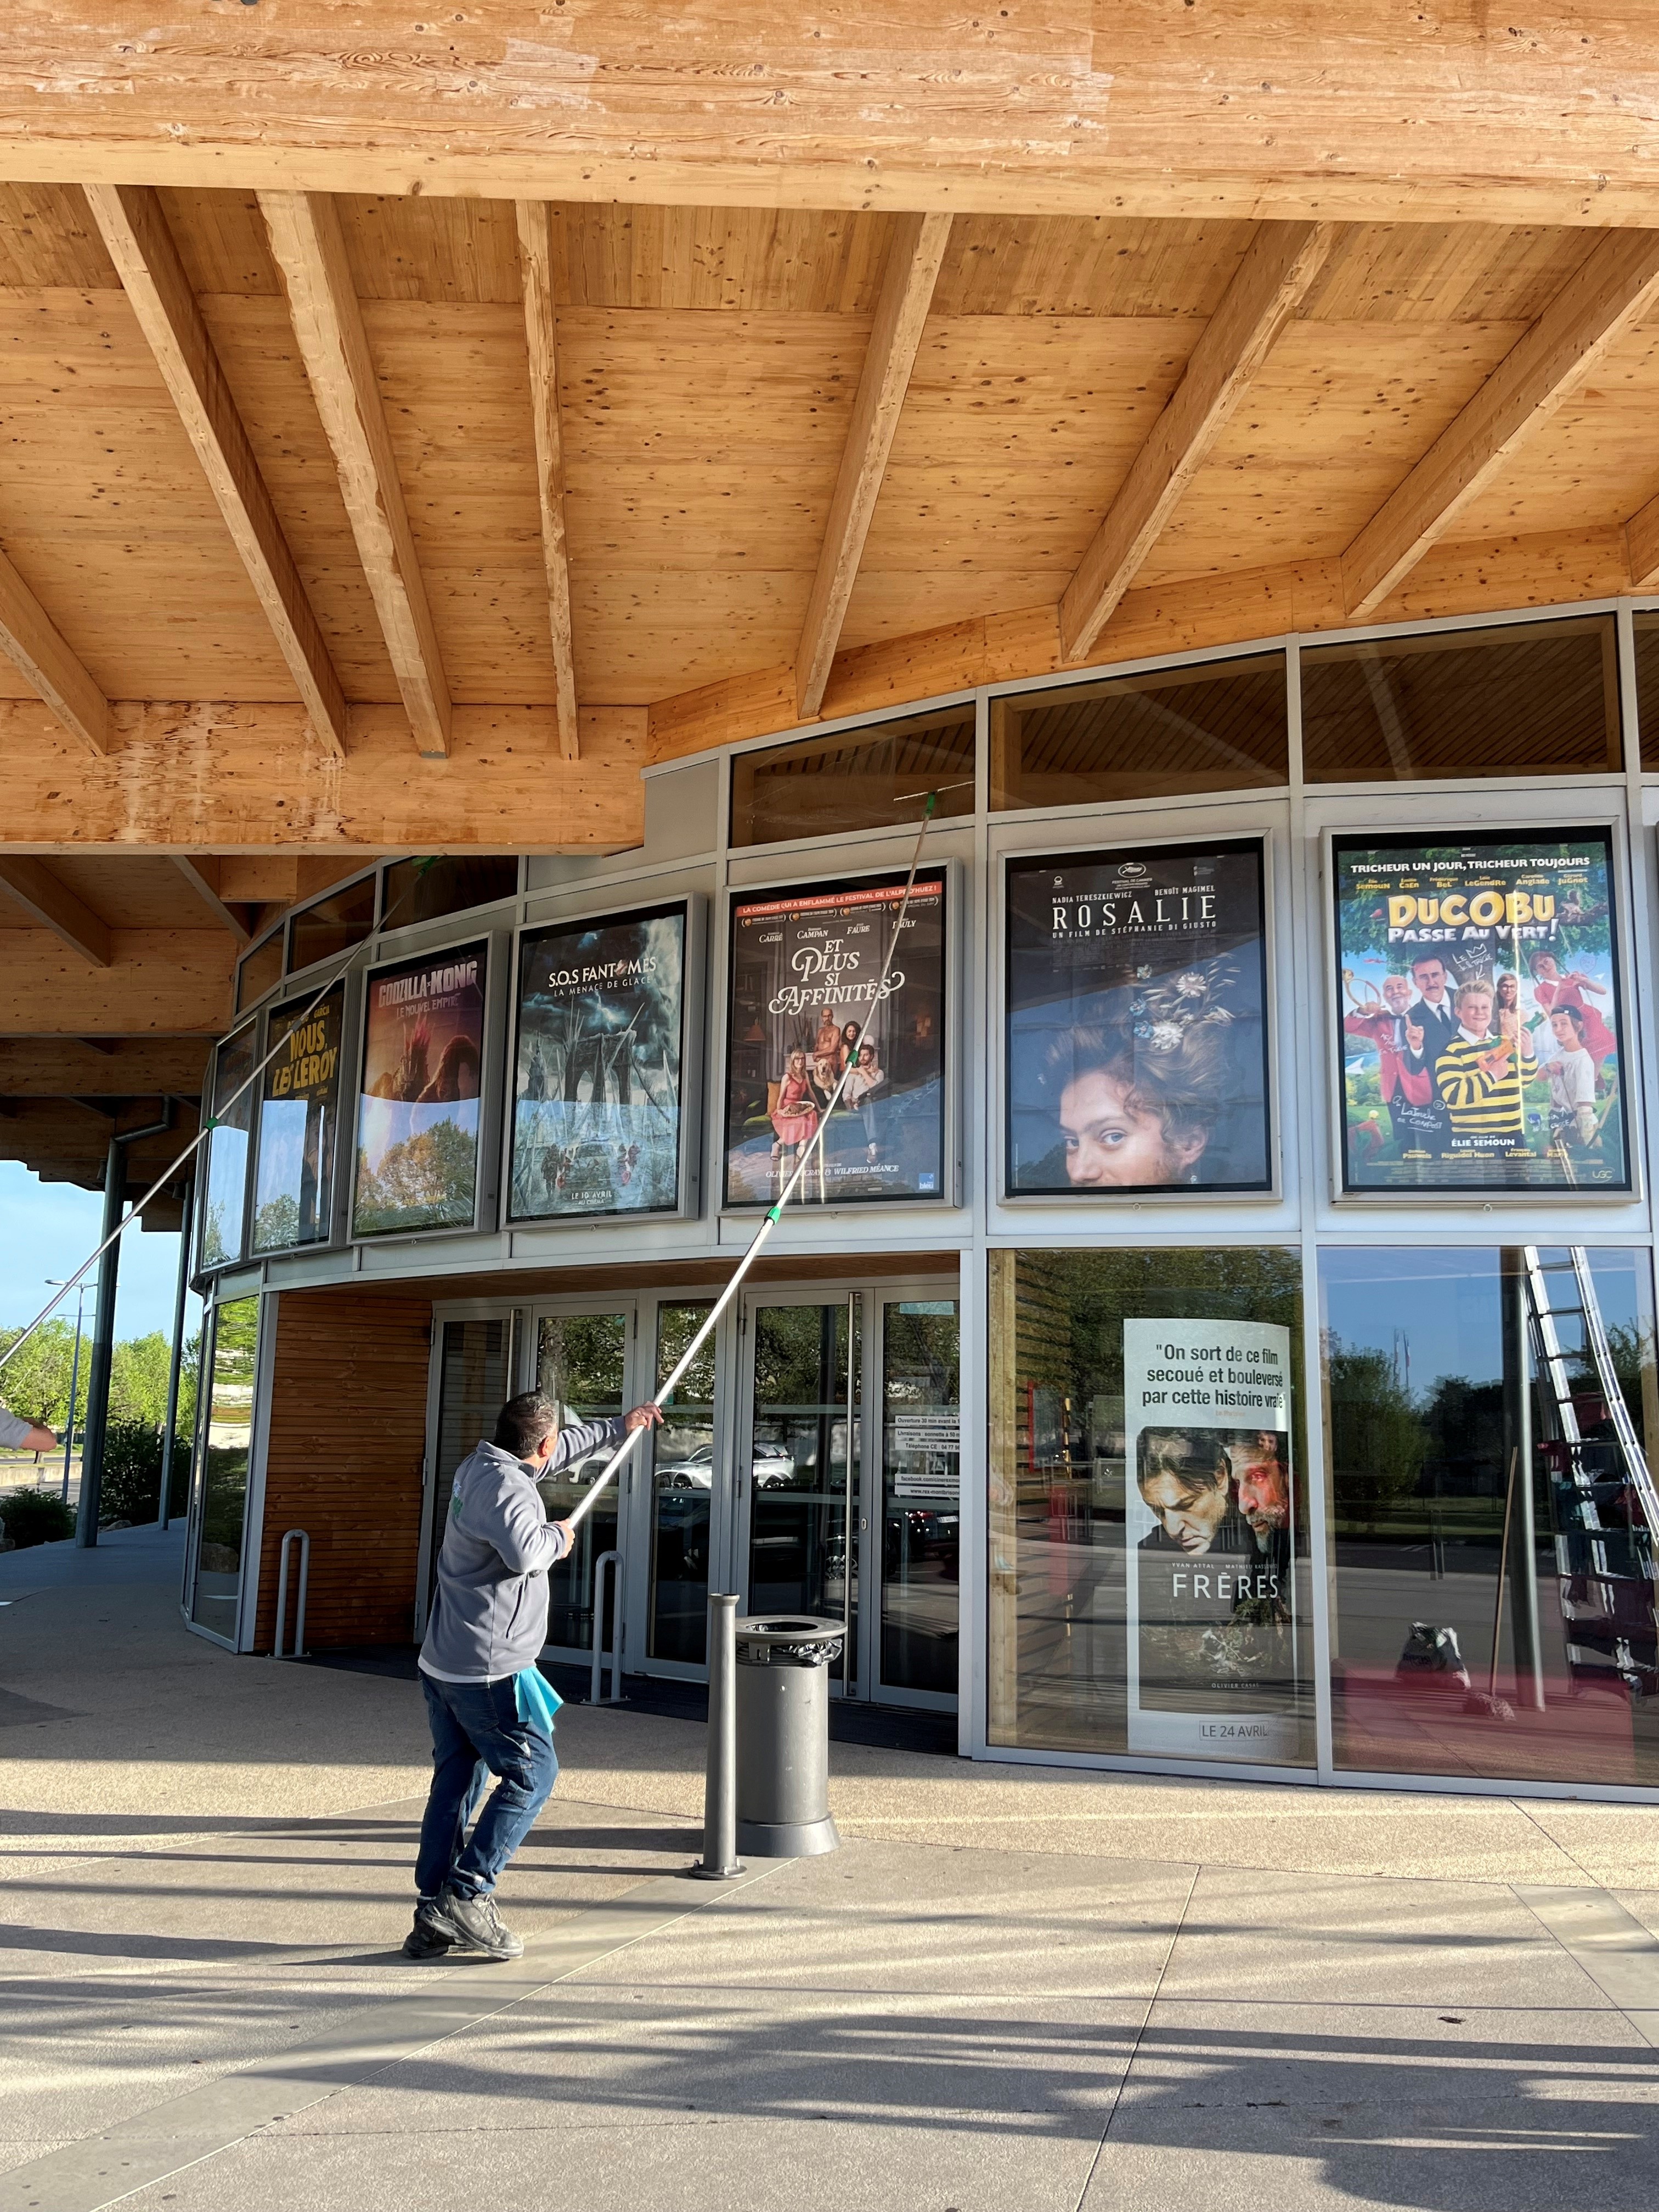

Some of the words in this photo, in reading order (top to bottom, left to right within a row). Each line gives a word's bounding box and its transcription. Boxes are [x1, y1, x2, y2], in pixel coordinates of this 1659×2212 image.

[1350, 863, 1410, 873] TRICHEUR
[1413, 862, 1431, 871] UN
[1433, 861, 1466, 872] JOUR,
[1467, 859, 1528, 869] TRICHEUR
[1530, 857, 1590, 868] TOUJOURS
[1076, 891, 1132, 901] TERESZKIEWICZ
[1154, 887, 1179, 896] BENOÎT
[1182, 885, 1216, 894] MAGIMEL
[752, 903, 780, 912] COMÉDIE
[799, 897, 835, 906] ENFLAMMÉ
[845, 892, 873, 901] FESTIVAL
[1388, 890, 1555, 927] DUCOBU
[1052, 895, 1216, 930] ROSALIE
[759, 933, 783, 943] CARRÉ
[797, 930, 828, 939] CAMPAN
[847, 925, 871, 934] FAURE
[1069, 930, 1090, 938] FILM
[1111, 924, 1163, 934] STÉPHANIE
[1183, 921, 1216, 929] GIUSTO
[1387, 928, 1457, 943] PASSE
[1462, 925, 1490, 940] AU
[824, 939, 844, 953] ET
[792, 947, 860, 982] PLUS
[379, 974, 427, 1008] GODZILLA
[430, 961, 477, 995] KONG
[549, 969, 579, 988] S.O.S
[569, 983, 603, 996] MENACE
[607, 980, 618, 989] DE
[622, 976, 651, 986] GLACE
[825, 973, 840, 986] SI
[768, 971, 905, 1015] AFFINITÉS
[397, 1007, 404, 1020] LE
[405, 1001, 430, 1017] NOUVEL
[294, 1046, 337, 1089] LEROY
[1452, 1138, 1471, 1147] ÉLIE
[825, 1168, 831, 1176] &
[834, 1166, 869, 1175] WILFRIED
[870, 1164, 899, 1173] MÉANCE
[1592, 1170, 1612, 1178] UGC
[1190, 1346, 1222, 1361] sort
[1226, 1346, 1242, 1362] de
[1246, 1350, 1259, 1363] ce
[1262, 1348, 1278, 1365] film
[1147, 1366, 1204, 1383] secoué
[1209, 1368, 1223, 1383] et
[1228, 1368, 1283, 1387] bouleversé
[1142, 1391, 1167, 1407] par
[1172, 1389, 1210, 1404] cette
[1215, 1389, 1262, 1407] histoire
[1173, 1572, 1278, 1599] FRÈRES
[1202, 1725, 1216, 1737] LE
[1220, 1725, 1234, 1737] 24
[1238, 1725, 1267, 1737] AVRIL
